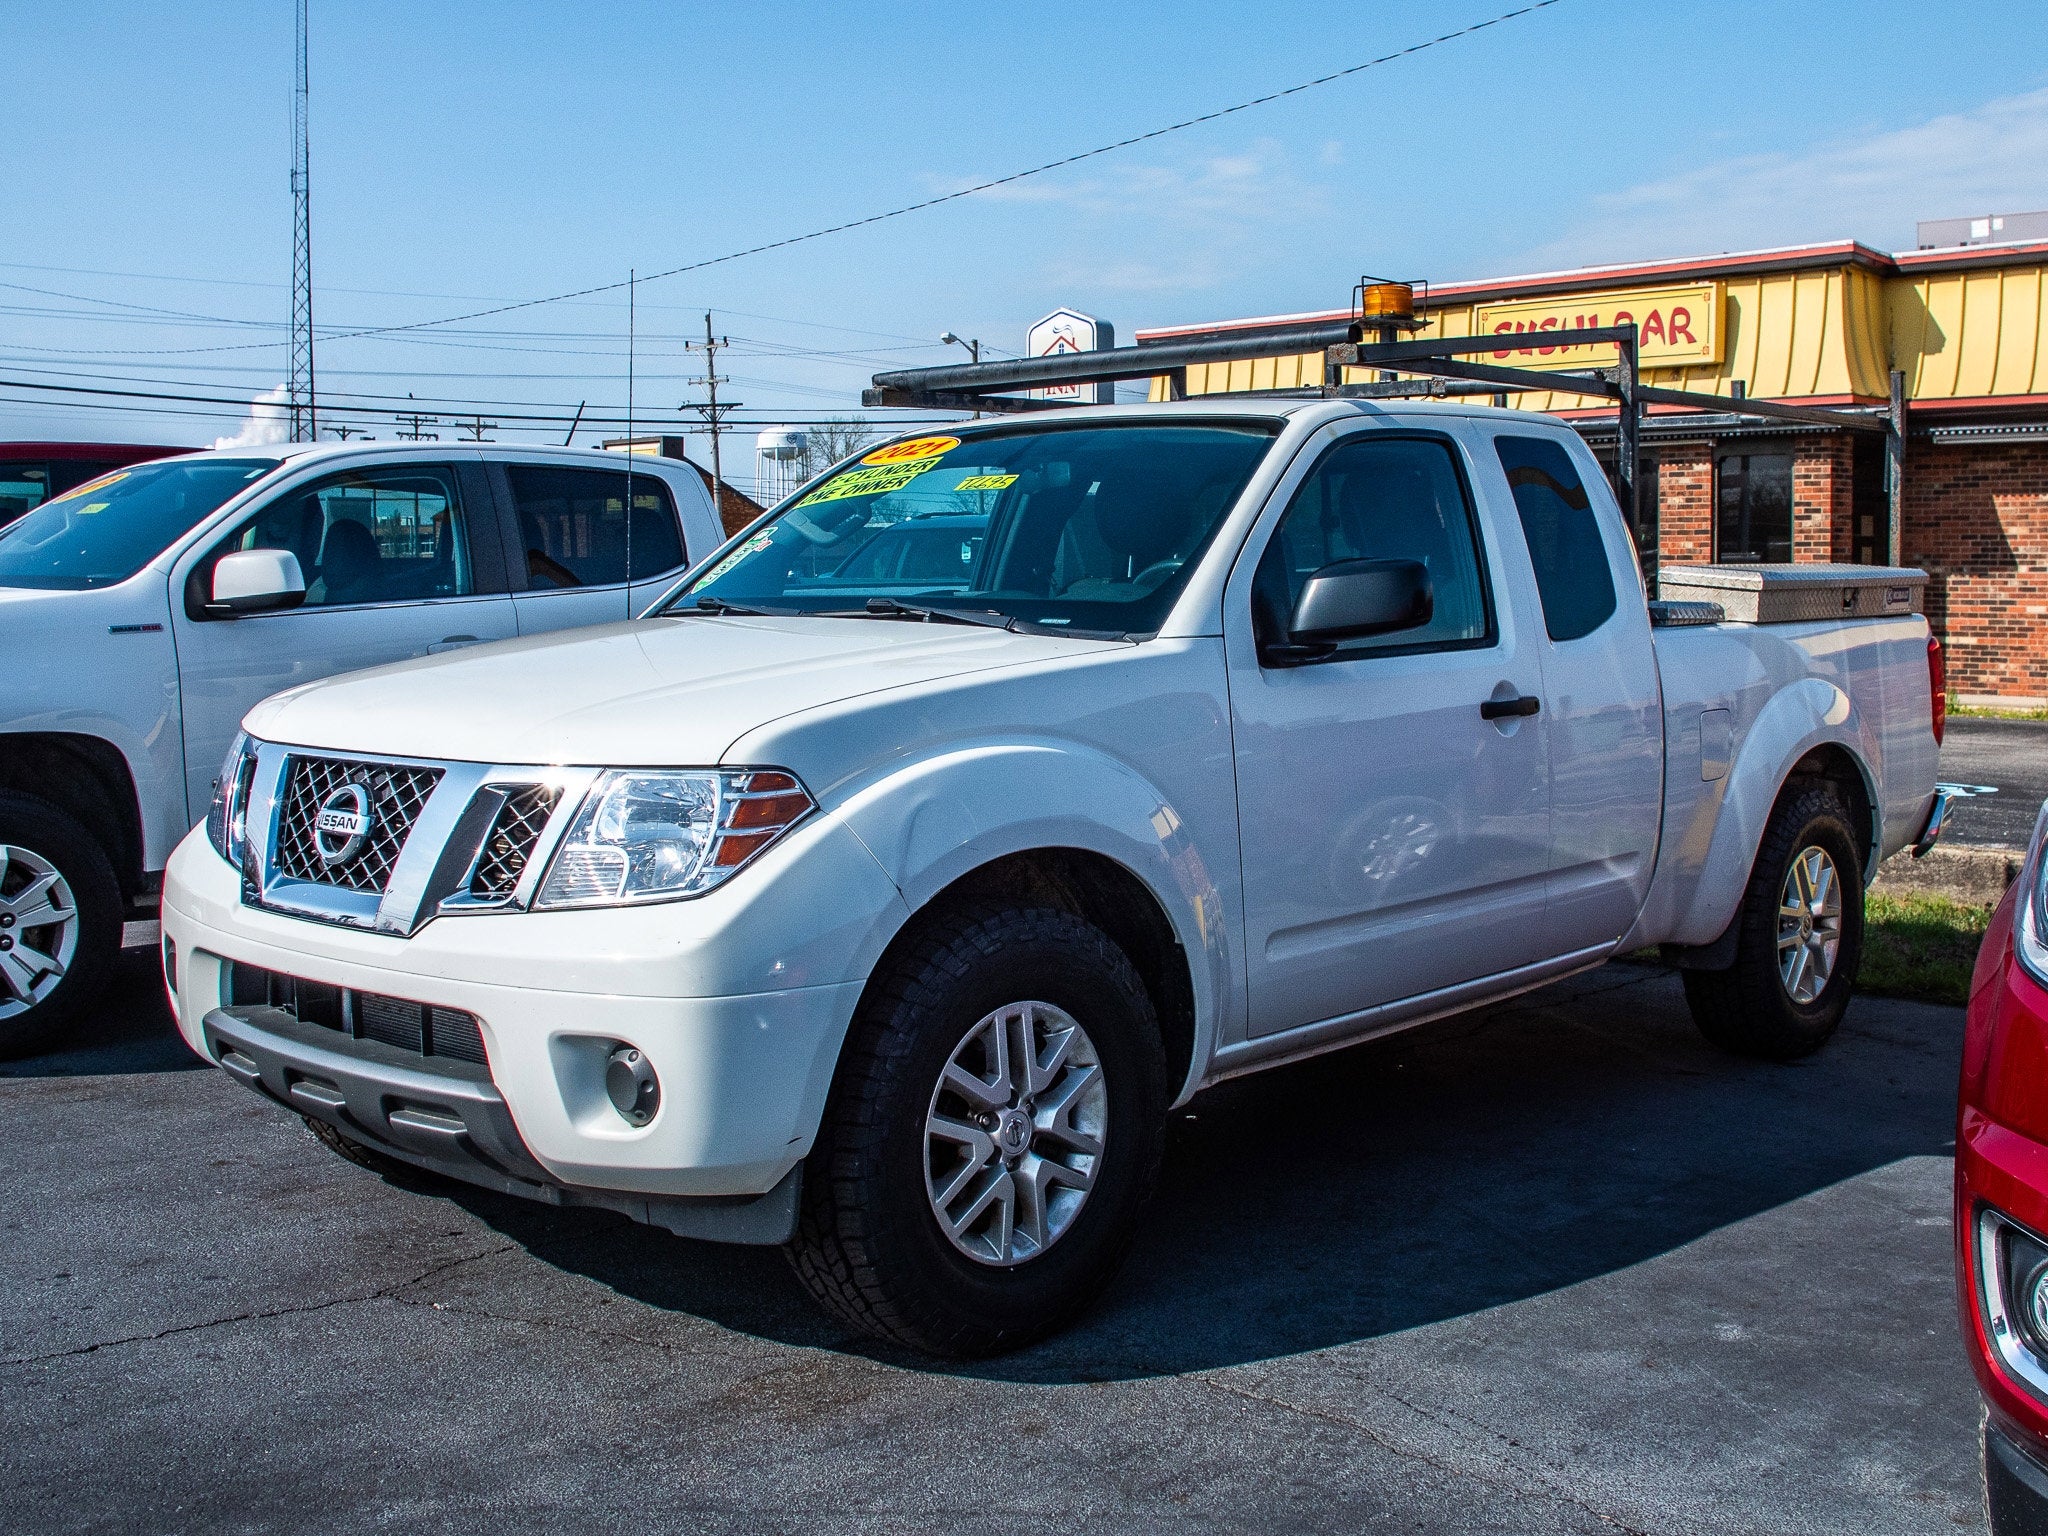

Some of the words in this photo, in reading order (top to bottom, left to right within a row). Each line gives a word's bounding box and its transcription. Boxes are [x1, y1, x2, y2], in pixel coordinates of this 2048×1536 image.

[1493, 313, 1598, 359] SUSHI
[1046, 385, 1075, 395] INN
[868, 440, 953, 460] 2021
[800, 486, 841, 506] ONE
[839, 475, 908, 497] OWNER
[317, 813, 358, 830] NISSAN
